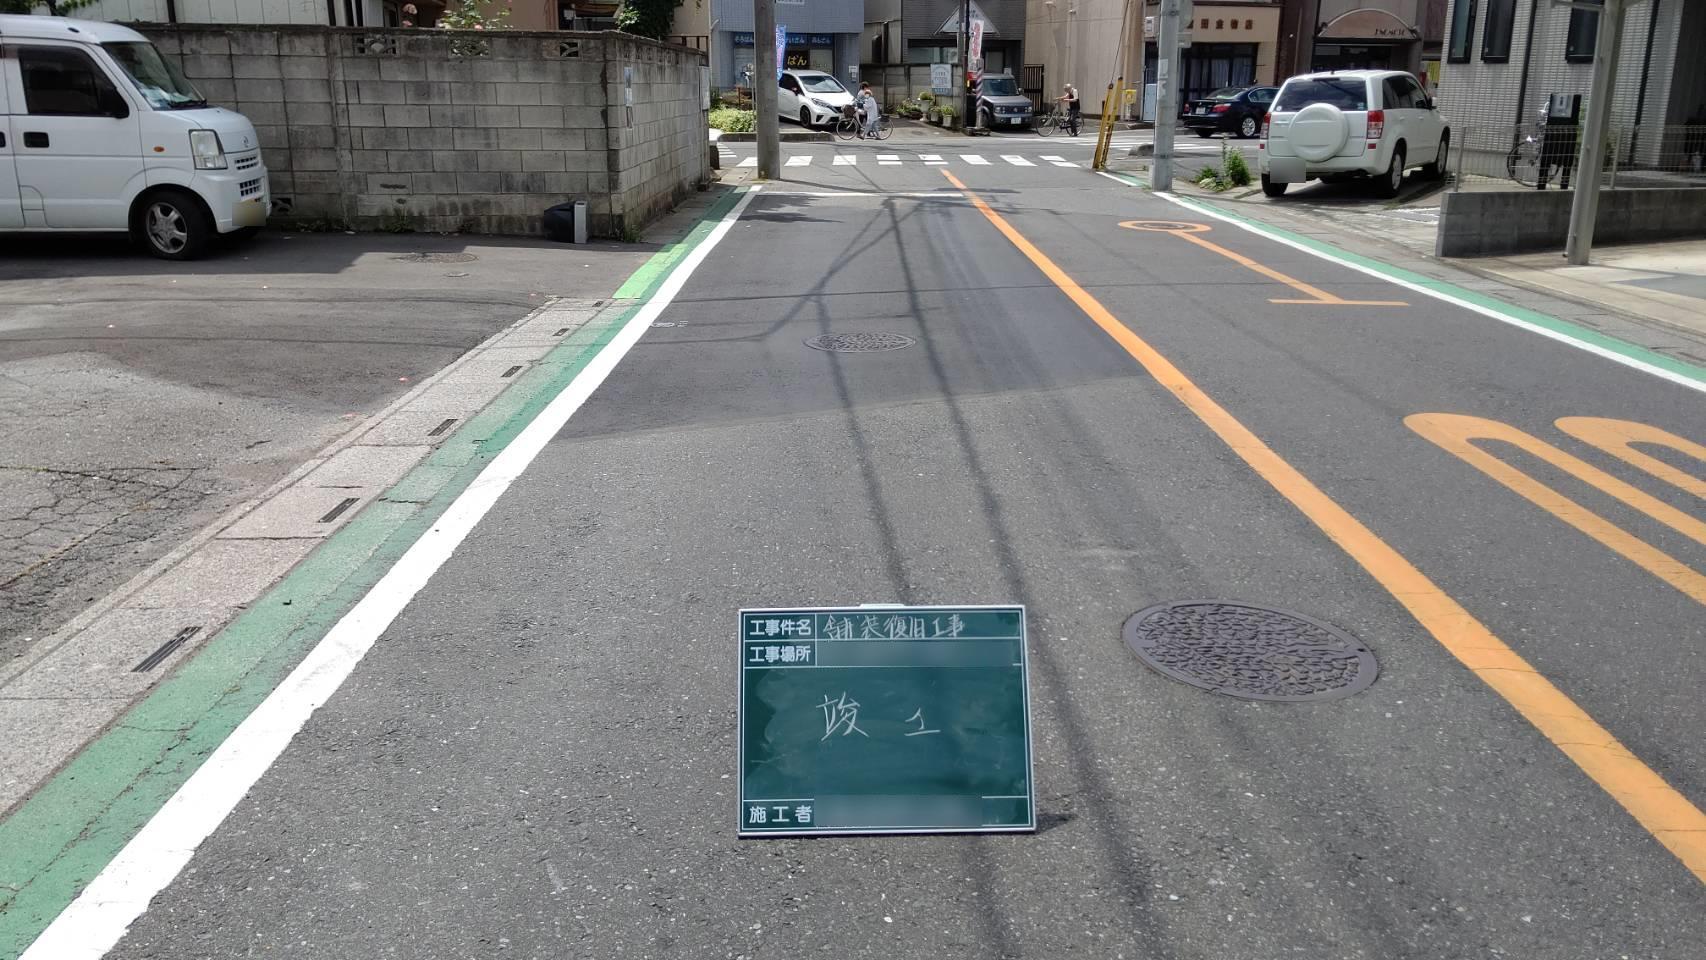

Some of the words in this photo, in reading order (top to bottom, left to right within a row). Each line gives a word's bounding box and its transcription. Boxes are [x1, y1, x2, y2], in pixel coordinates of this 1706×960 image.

[1187, 18, 1253, 30] 田金物店
[749, 619, 812, 636] 工事件名
[822, 614, 966, 640] 舗装復旧工事
[749, 645, 812, 663] 工事場所
[749, 805, 813, 824] 施工者
